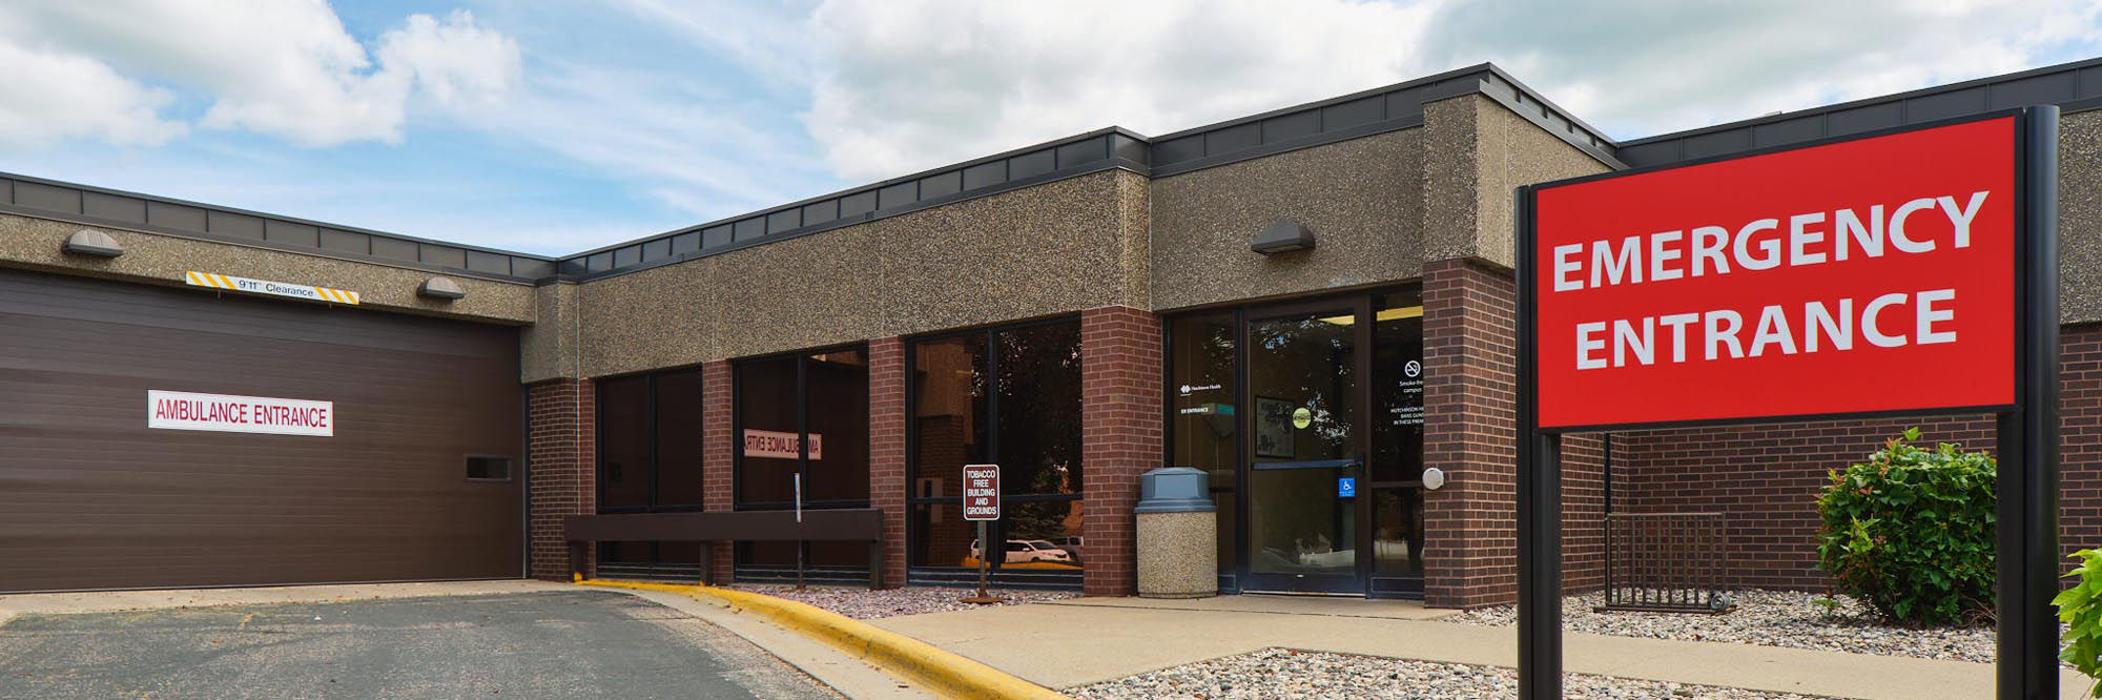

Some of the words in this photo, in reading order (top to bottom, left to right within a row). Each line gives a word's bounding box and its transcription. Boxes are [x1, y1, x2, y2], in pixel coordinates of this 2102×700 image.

[1553, 189, 1991, 293] EMERGENCY
[265, 283, 314, 297] Clearance
[1576, 288, 1958, 371] ENTRANCE
[156, 398, 248, 424] AMBULANCE
[254, 404, 327, 428] ENTRANCE
[967, 470, 996, 479] TOBACCO
[973, 479, 989, 488] FREE
[967, 488, 996, 497] BUILDING
[975, 497, 989, 506] AND
[967, 506, 997, 515] GROUNDS
